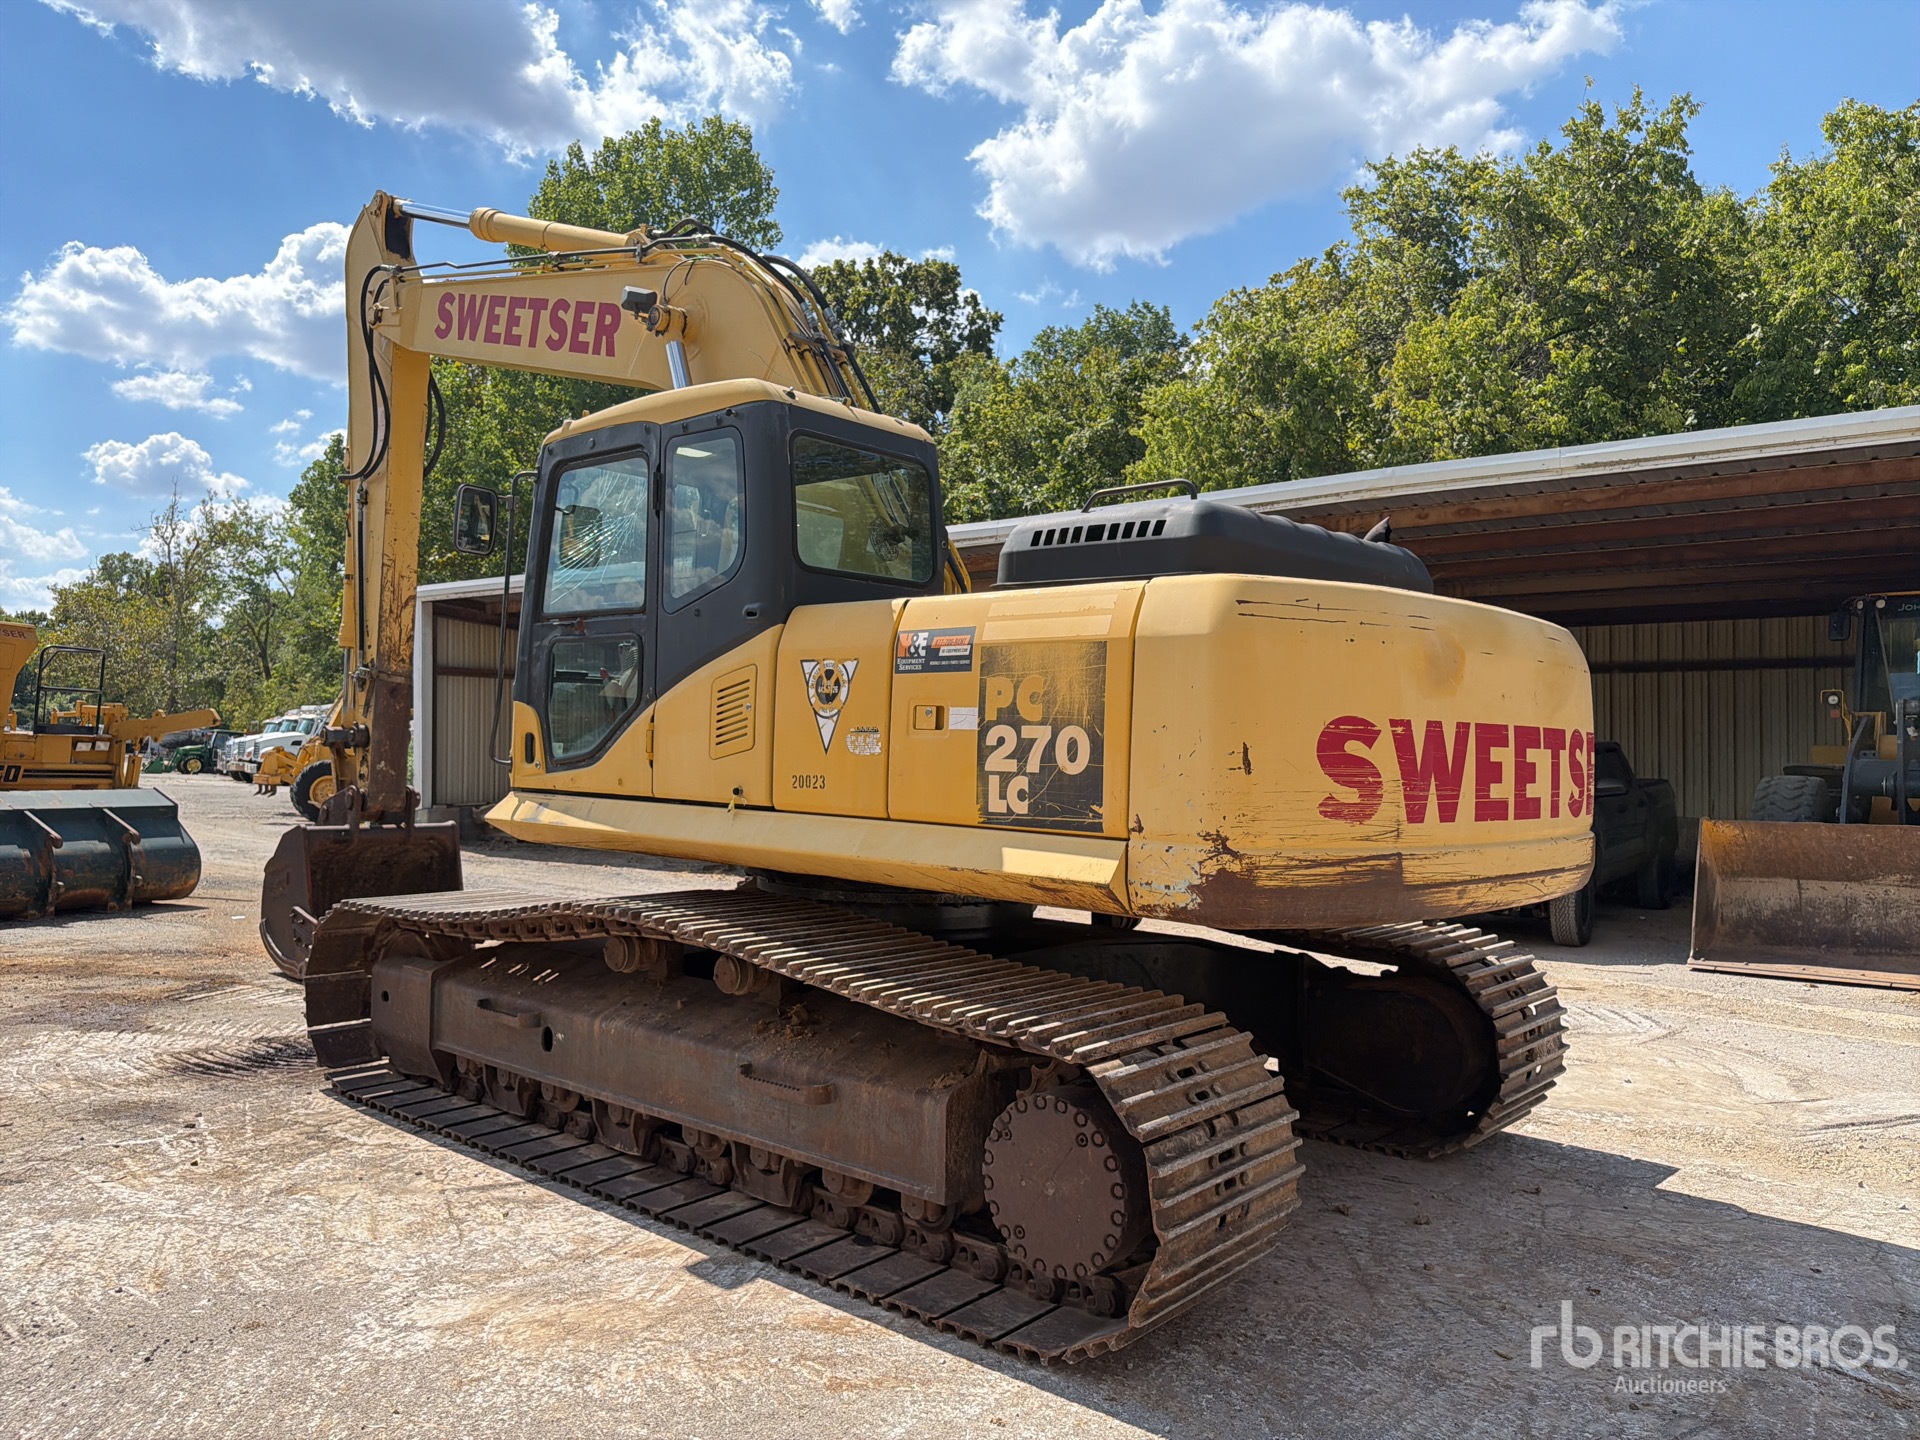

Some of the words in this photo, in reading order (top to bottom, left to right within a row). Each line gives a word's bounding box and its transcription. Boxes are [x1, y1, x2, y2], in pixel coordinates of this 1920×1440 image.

[434, 292, 622, 358] SWEETSER
[897, 632, 929, 657] H&E
[985, 675, 1044, 722] PC
[984, 724, 1091, 776] 270
[792, 774, 825, 789] 20023
[988, 775, 1029, 815] LC
